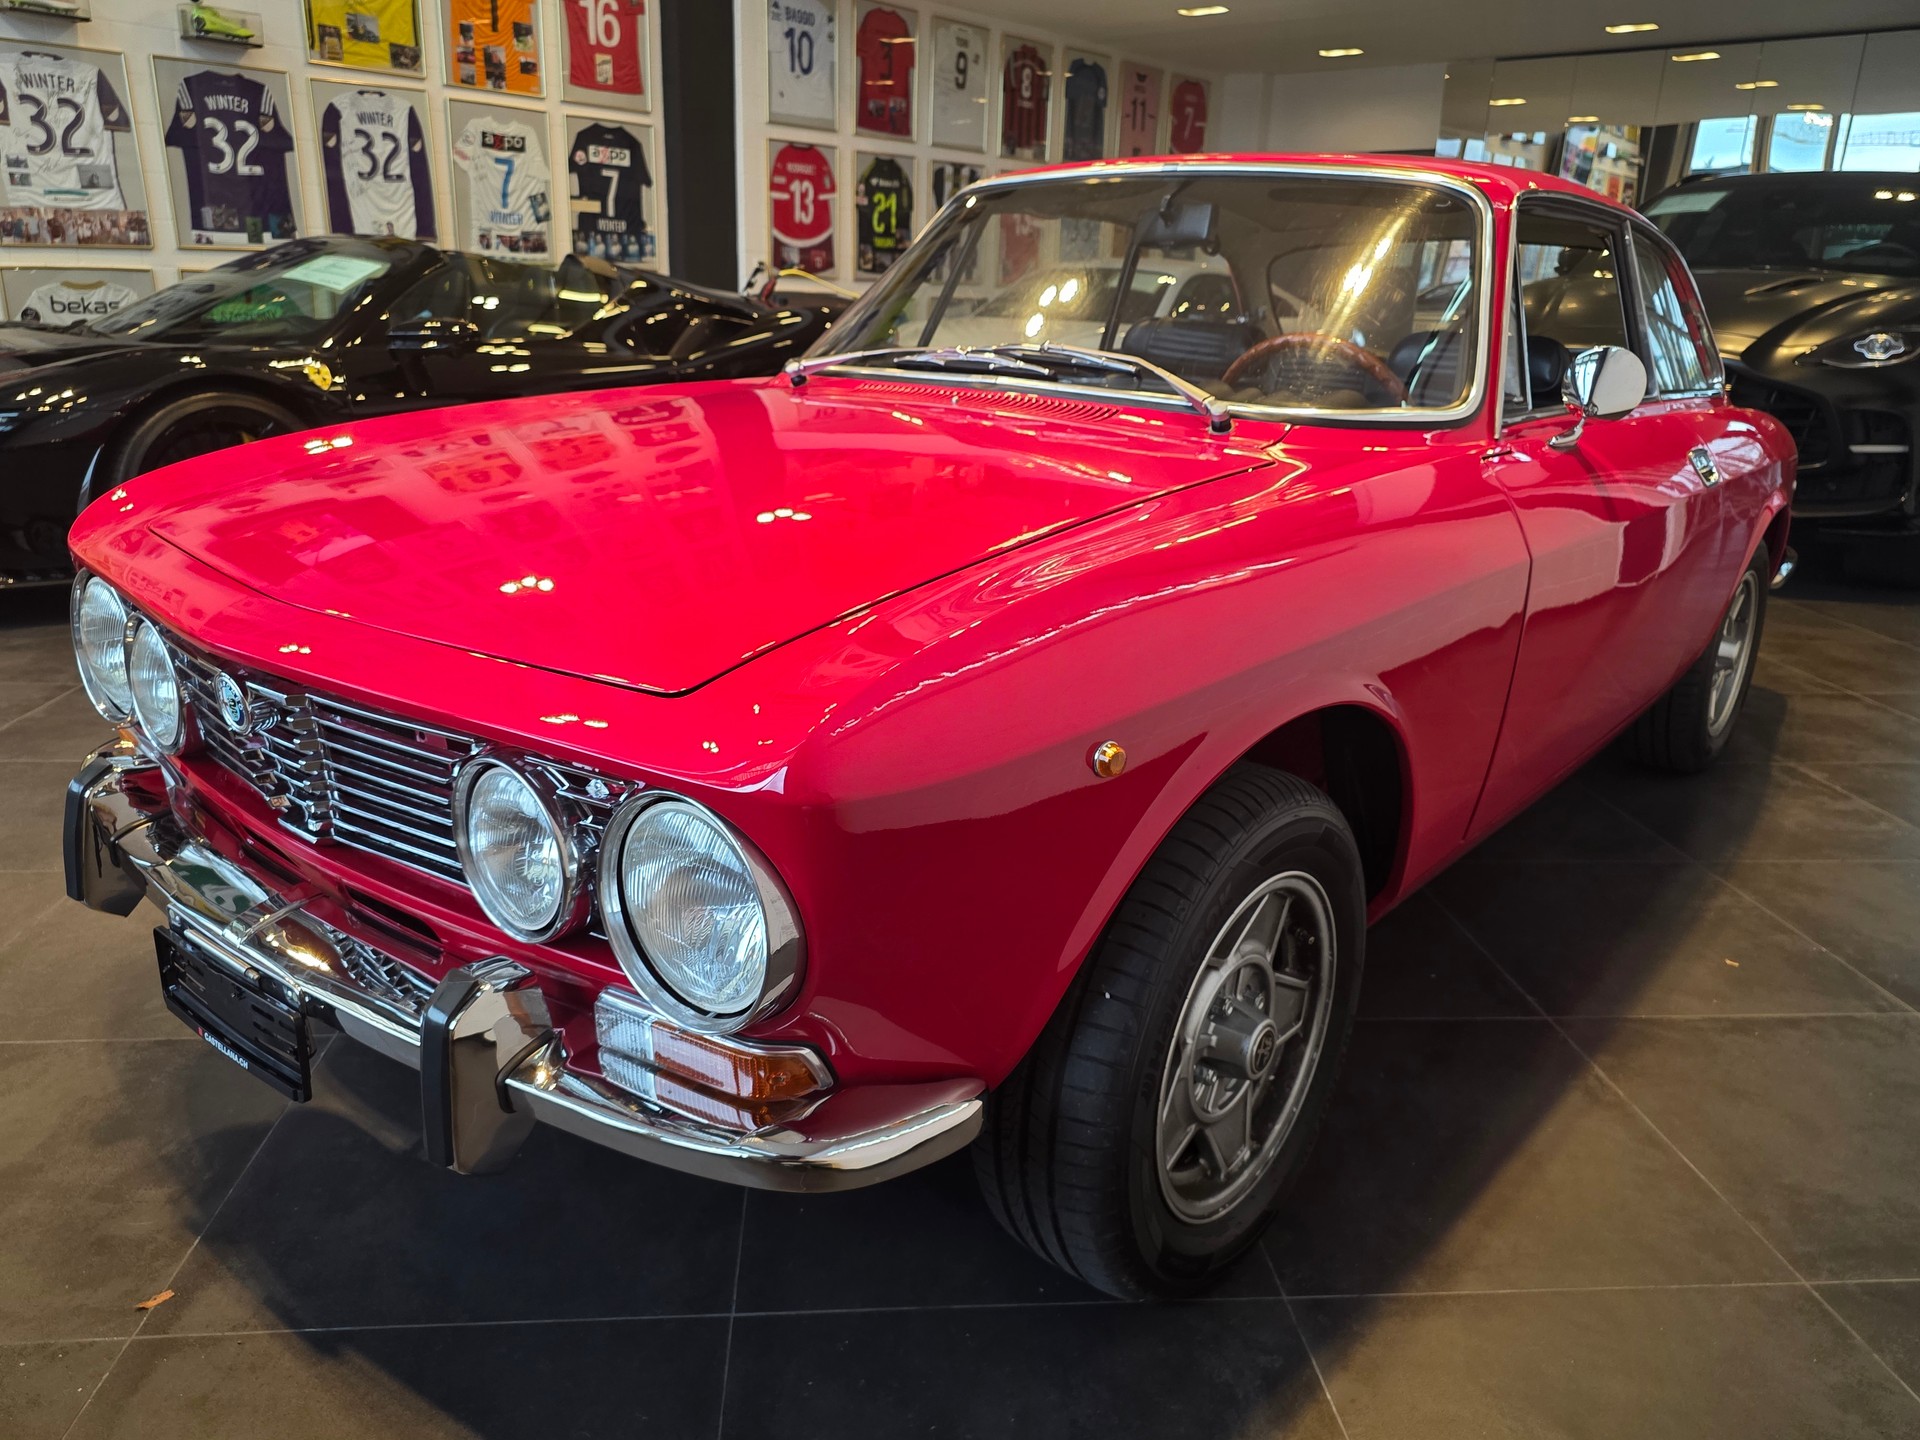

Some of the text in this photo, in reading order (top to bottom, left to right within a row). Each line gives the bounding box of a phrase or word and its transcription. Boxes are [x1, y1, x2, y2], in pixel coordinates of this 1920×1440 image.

[578, 0, 621, 48] 16
[784, 27, 814, 76] 10
[954, 51, 968, 90] 9
[20, 73, 75, 93] WINTER
[1021, 67, 1033, 99] 8
[204, 95, 249, 114] WINTER
[356, 111, 394, 128] WINTER
[1132, 97, 1146, 132] 11
[1184, 107, 1194, 140] 7
[18, 94, 95, 157] 32
[484, 133, 523, 151] axpo
[203, 117, 264, 176] 32
[354, 128, 406, 183] 32
[495, 157, 515, 209] 7
[601, 168, 620, 217] 7
[789, 179, 815, 225] 13
[872, 192, 897, 234] 21
[204, 1032, 249, 1070] CASTELLANA.CH
